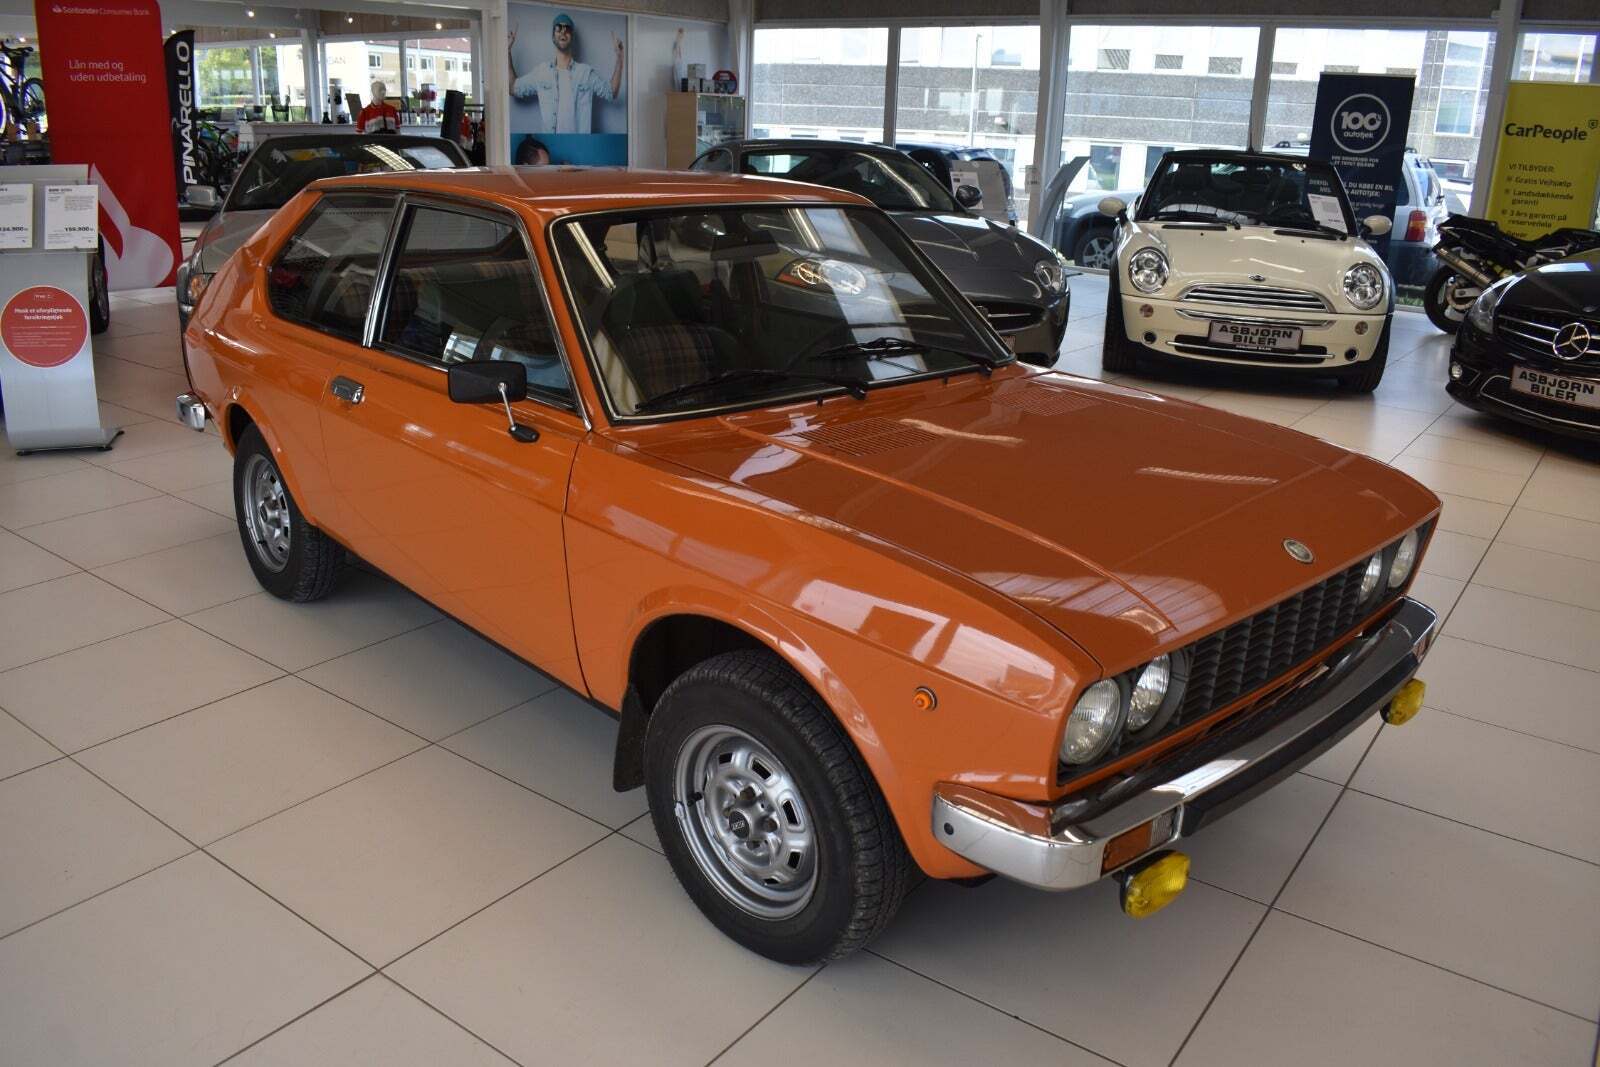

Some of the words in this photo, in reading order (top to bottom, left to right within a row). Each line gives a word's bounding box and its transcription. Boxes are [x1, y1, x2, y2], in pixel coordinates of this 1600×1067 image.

[62, 7, 99, 15] Santander
[69, 60, 87, 70] Lån
[88, 60, 110, 70] med
[111, 62, 124, 72] og
[70, 73, 95, 82] uden
[96, 73, 147, 84] udbetaling
[176, 41, 198, 185] PINARELLO
[1343, 131, 1374, 140] autotjek
[1505, 122, 1588, 143] CarPeople
[1515, 176, 1537, 185] Gratis
[1512, 198, 1538, 206] garanti
[1219, 325, 1293, 339] ASBJØRN
[1232, 334, 1277, 346] BILER
[1518, 371, 1595, 394] ASBJØRN
[1530, 384, 1577, 402] BILER
